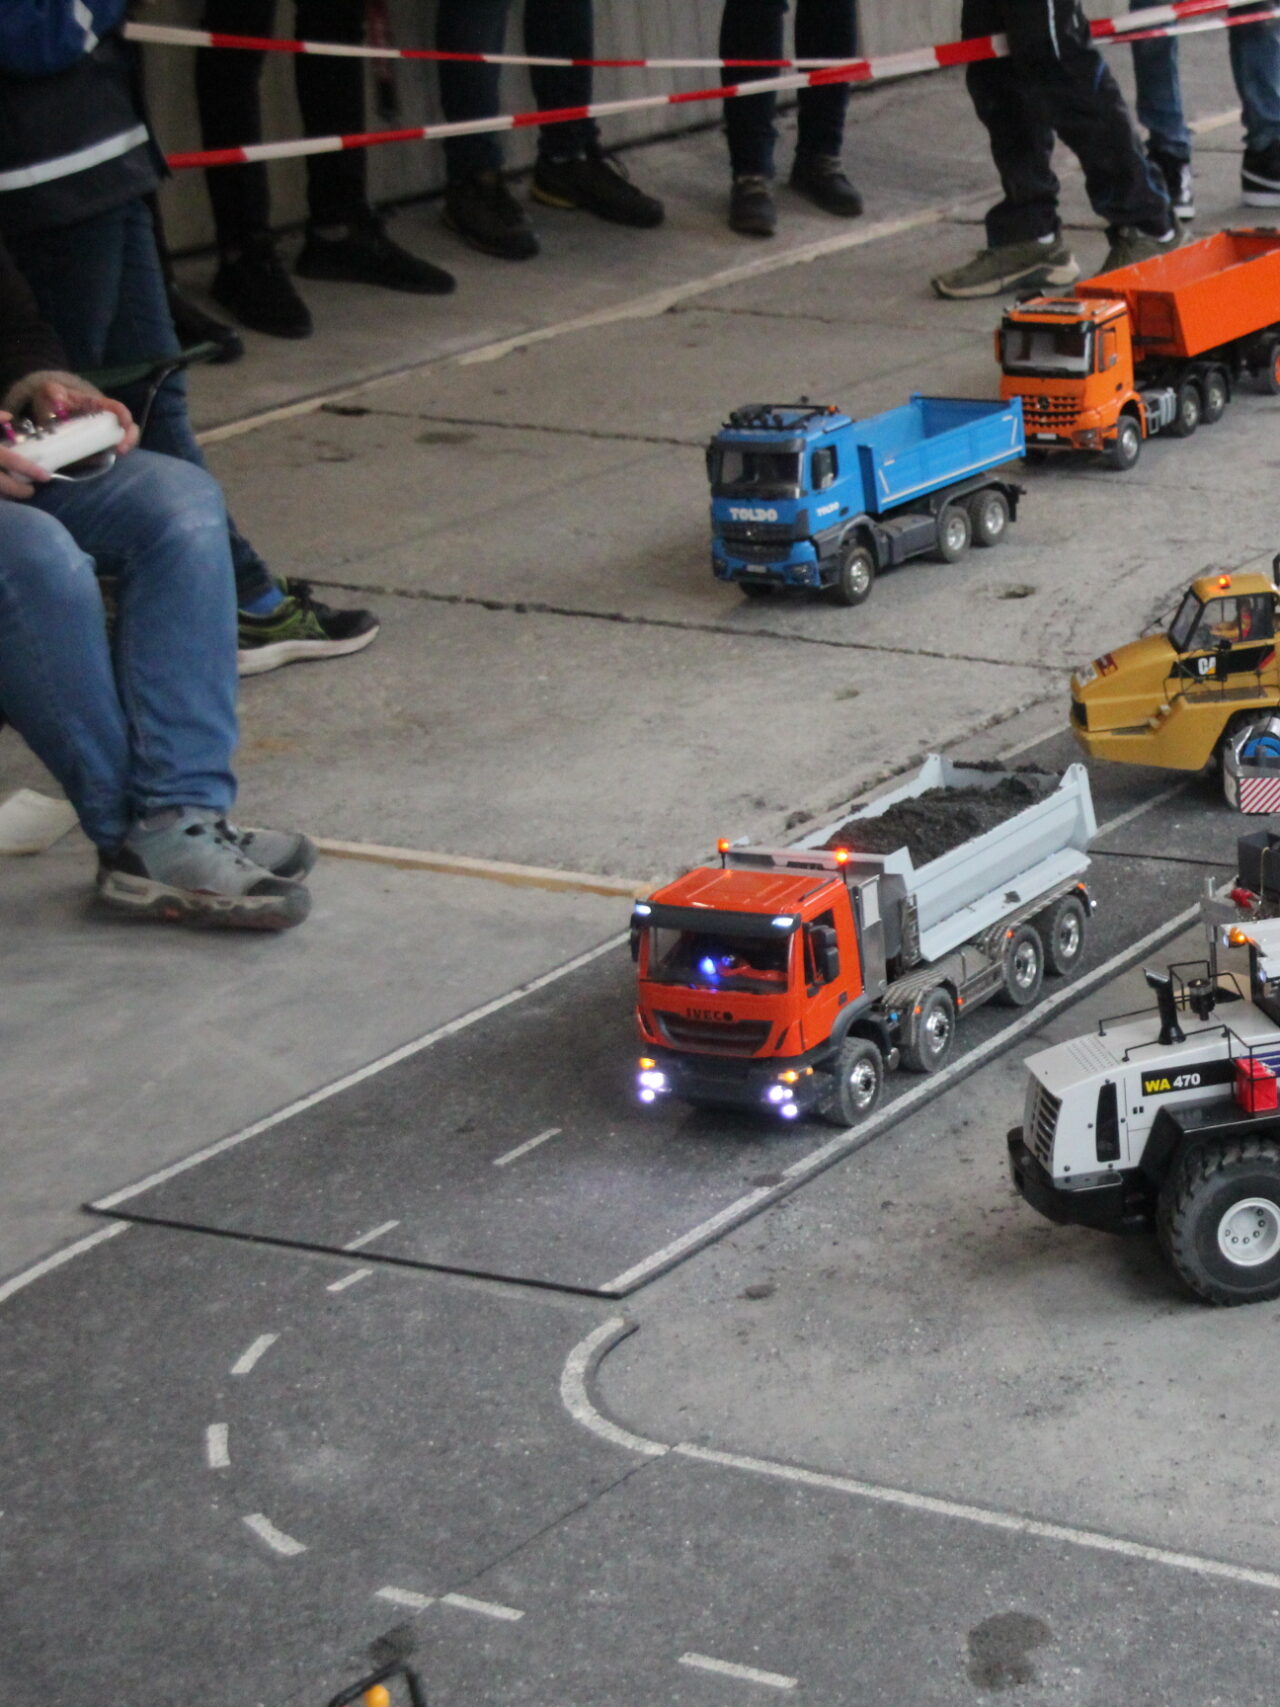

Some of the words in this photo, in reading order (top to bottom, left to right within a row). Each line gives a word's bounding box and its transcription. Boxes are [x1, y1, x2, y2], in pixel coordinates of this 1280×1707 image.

[729, 507, 778, 522] TOLDO
[686, 1007, 733, 1021] IVECO
[1145, 1078, 1171, 1093] WA
[1173, 1072, 1201, 1088] 470
